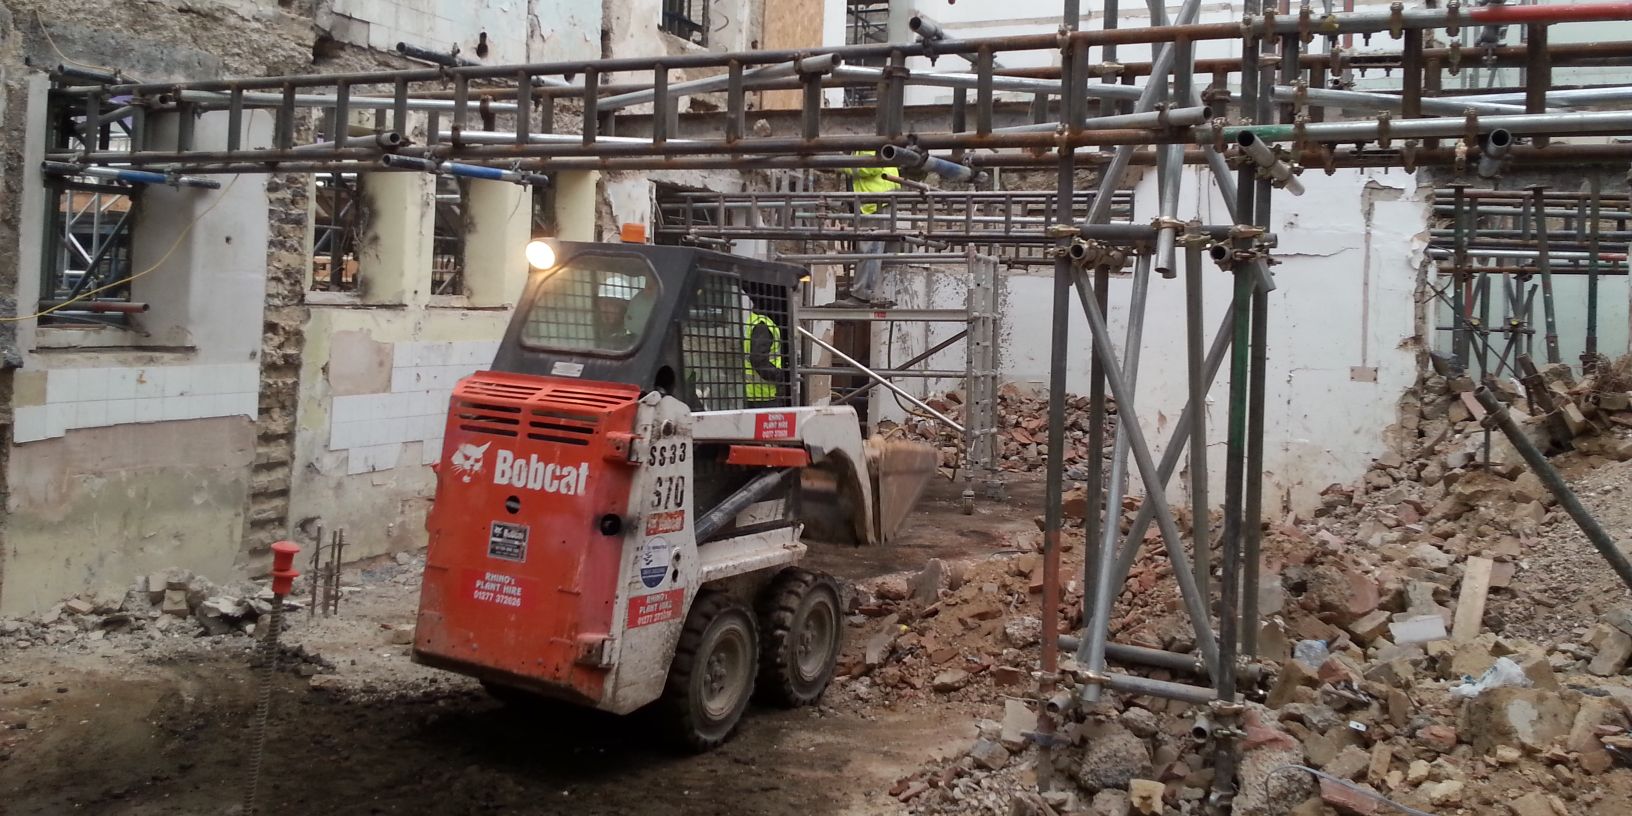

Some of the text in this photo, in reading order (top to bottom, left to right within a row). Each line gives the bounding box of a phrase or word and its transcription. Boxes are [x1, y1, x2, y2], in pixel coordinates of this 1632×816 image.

[649, 442, 686, 467] SS33
[493, 449, 589, 496] Bobcat
[473, 590, 494, 602] 01277
[475, 579, 522, 596] PLANT HIRE
[639, 603, 658, 614] PLANT
